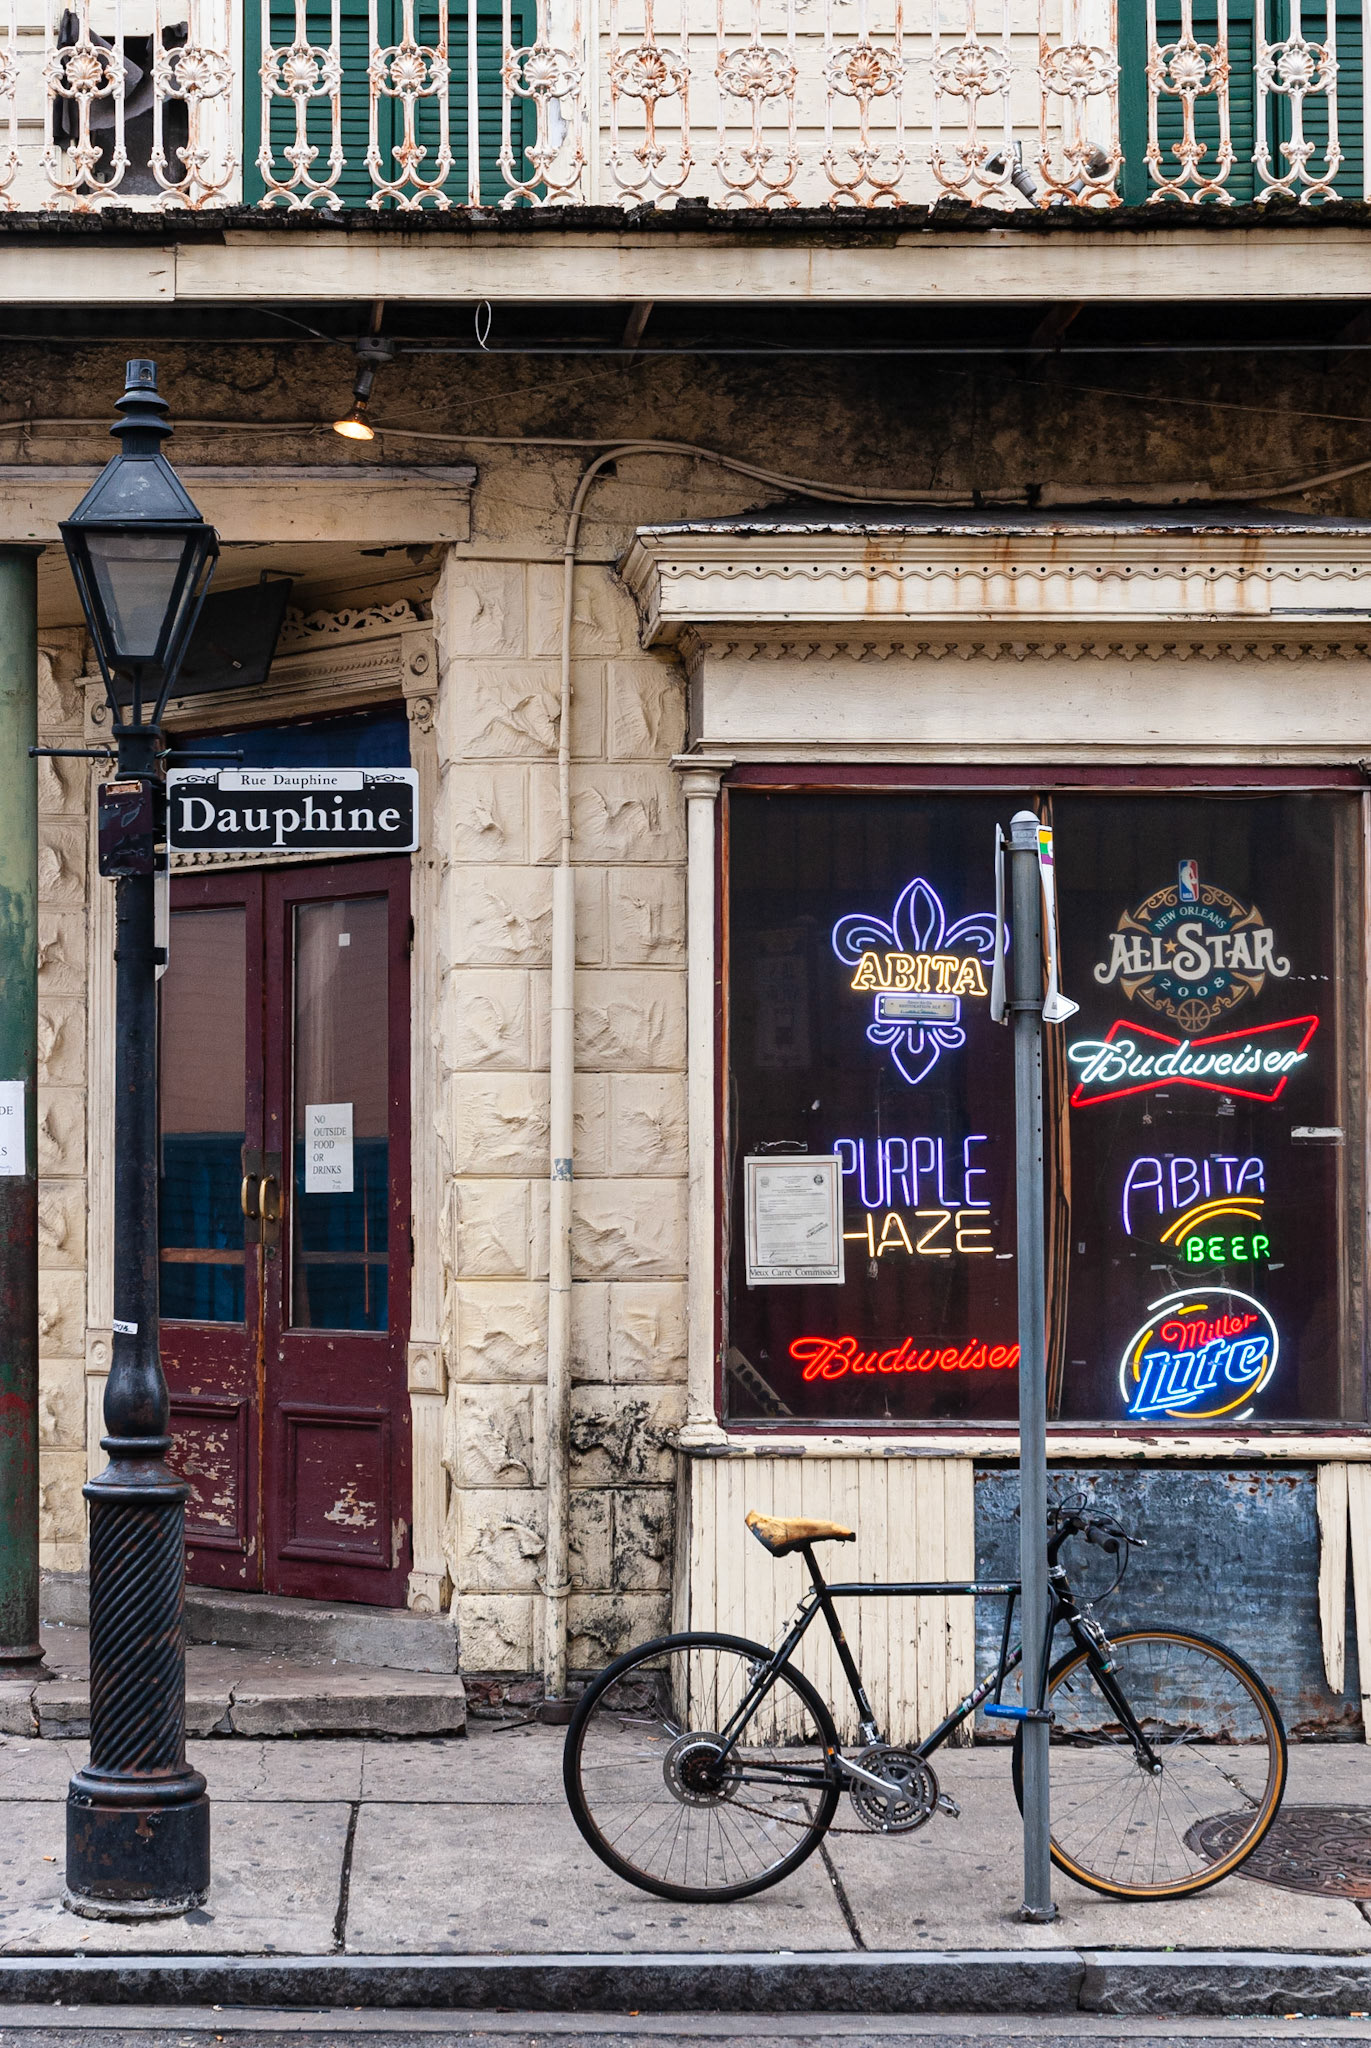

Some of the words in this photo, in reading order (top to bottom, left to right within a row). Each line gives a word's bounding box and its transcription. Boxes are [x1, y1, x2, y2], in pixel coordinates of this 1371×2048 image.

[241, 775, 267, 786] Rue
[273, 774, 338, 788] Dauphine
[178, 795, 401, 846] Dauphine
[1155, 909, 1176, 931] NEW
[1179, 906, 1227, 929] ORLEANS
[1093, 933, 1172, 984] ALL
[1172, 922, 1291, 980] STAR
[850, 951, 989, 997] ABITA
[1160, 976, 1226, 997] 2008
[1067, 1039, 1308, 1083] Budweiser
[313, 1127, 347, 1137] OUTSIDE
[314, 1115, 326, 1124] NO
[312, 1153, 324, 1162] OR
[313, 1140, 335, 1149] FOOD
[312, 1165, 342, 1175] DRINKS
[833, 1135, 991, 1208] PURPLE
[1122, 1157, 1266, 1235] ABITA
[1186, 1234, 1271, 1262] BEER
[1160, 1314, 1258, 1352] Miller
[788, 1336, 1021, 1381] Budweiser
[1128, 1336, 1269, 1413] Lite
